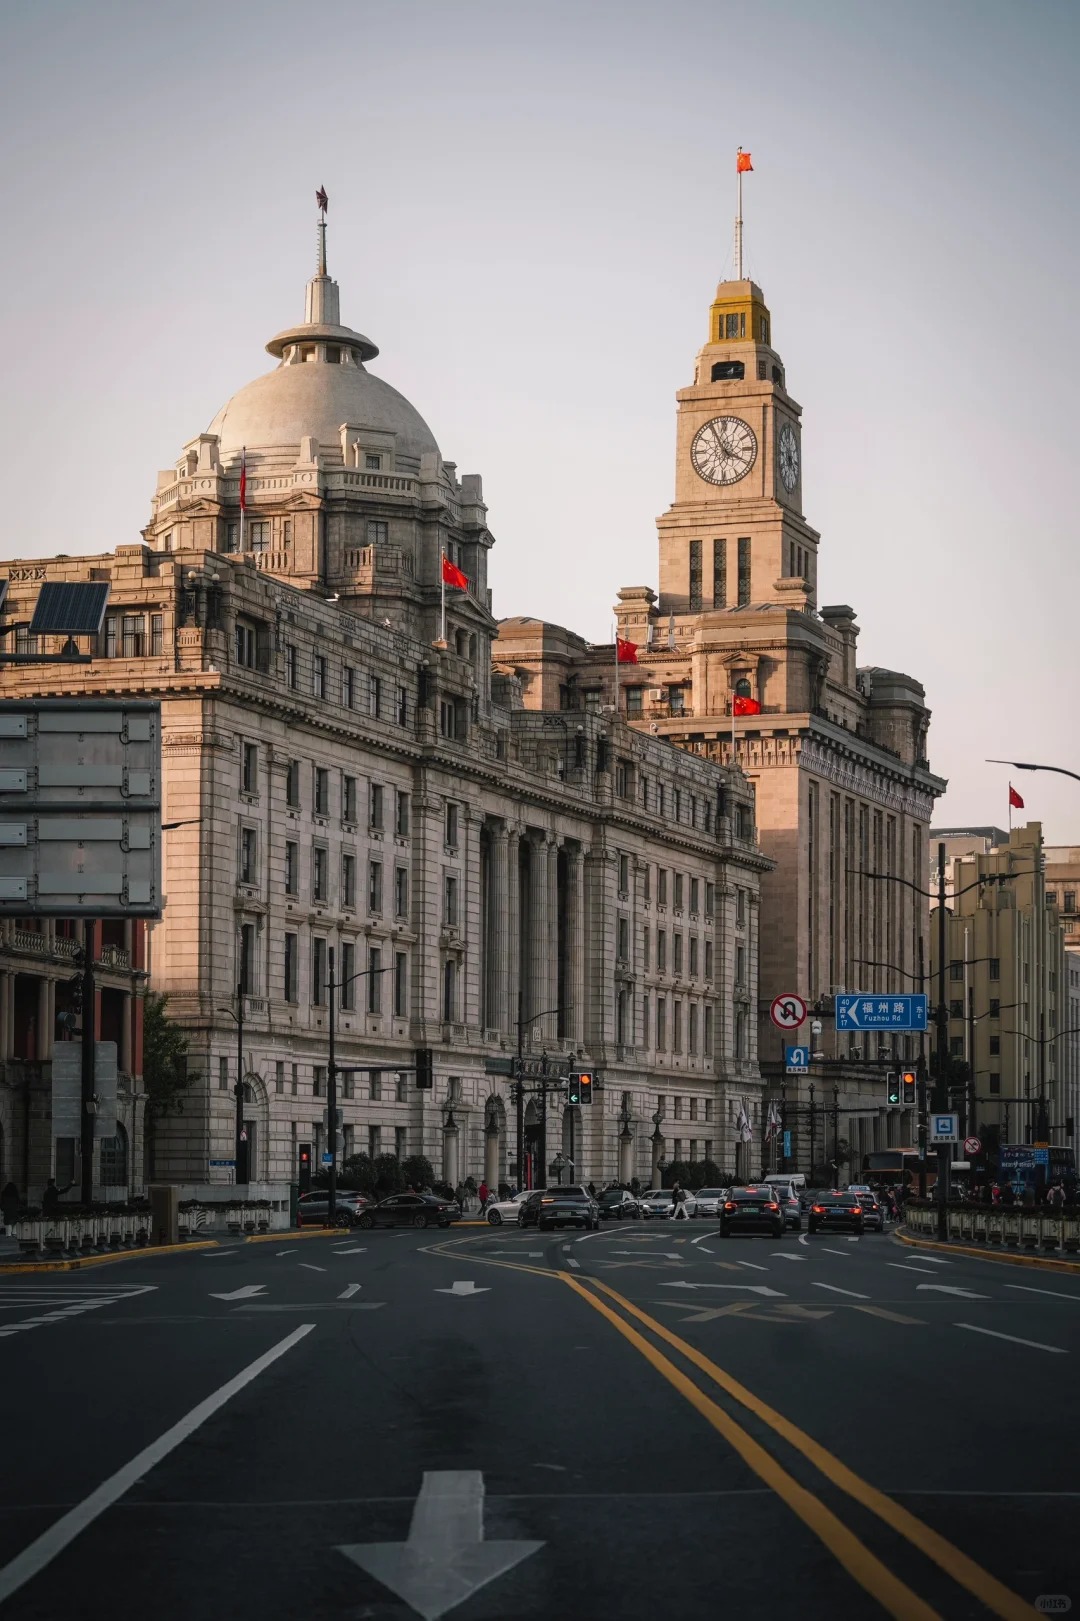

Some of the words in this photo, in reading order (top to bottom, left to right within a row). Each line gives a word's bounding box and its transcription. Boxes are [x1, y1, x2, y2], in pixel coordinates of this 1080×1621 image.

[839, 1006, 847, 1014] 西
[862, 1002, 904, 1014] 福州路
[916, 1006, 923, 1014] 东
[864, 1014, 890, 1022] Fuzhou
[892, 1014, 901, 1022] Rd
